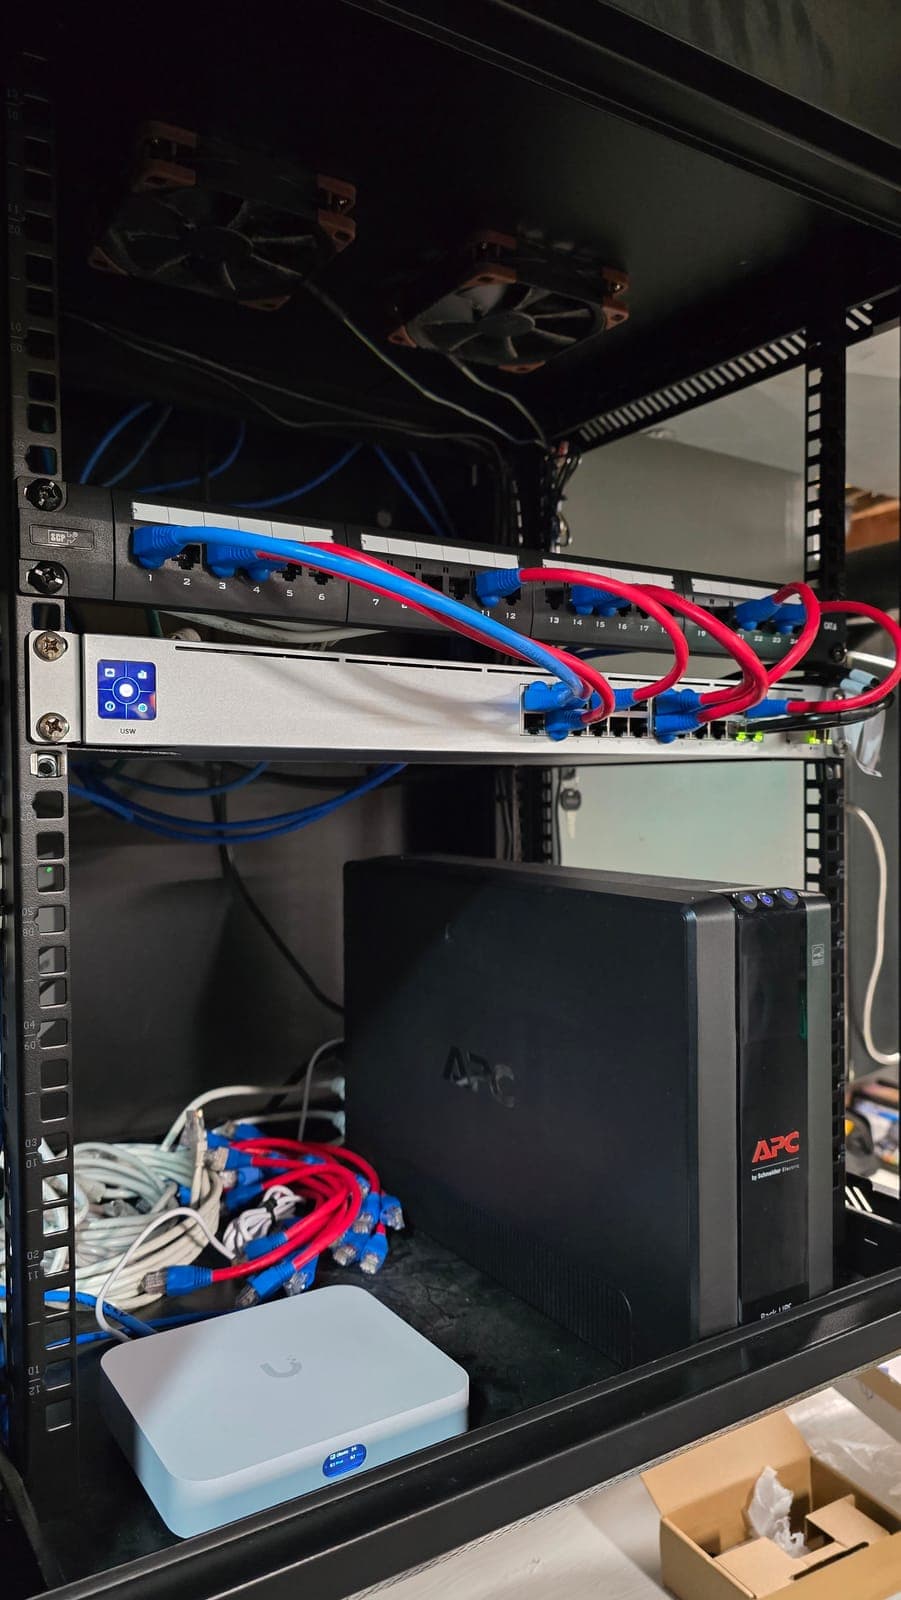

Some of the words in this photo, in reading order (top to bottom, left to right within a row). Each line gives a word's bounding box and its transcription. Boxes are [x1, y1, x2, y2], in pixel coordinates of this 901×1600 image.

[50, 532, 66, 542] SCP
[183, 577, 191, 586] 2
[218, 582, 226, 590] 3
[252, 586, 261, 594] 4
[286, 589, 294, 598] 5
[318, 593, 326, 601] 6
[372, 598, 380, 606] 7
[480, 609, 490, 617] 11
[506, 612, 516, 620] 12
[549, 616, 560, 625] 13
[573, 618, 583, 626] 14
[596, 621, 606, 629] 15
[618, 623, 628, 631] 16
[441, 1045, 516, 1109] APC
[752, 1130, 800, 1163] APC
